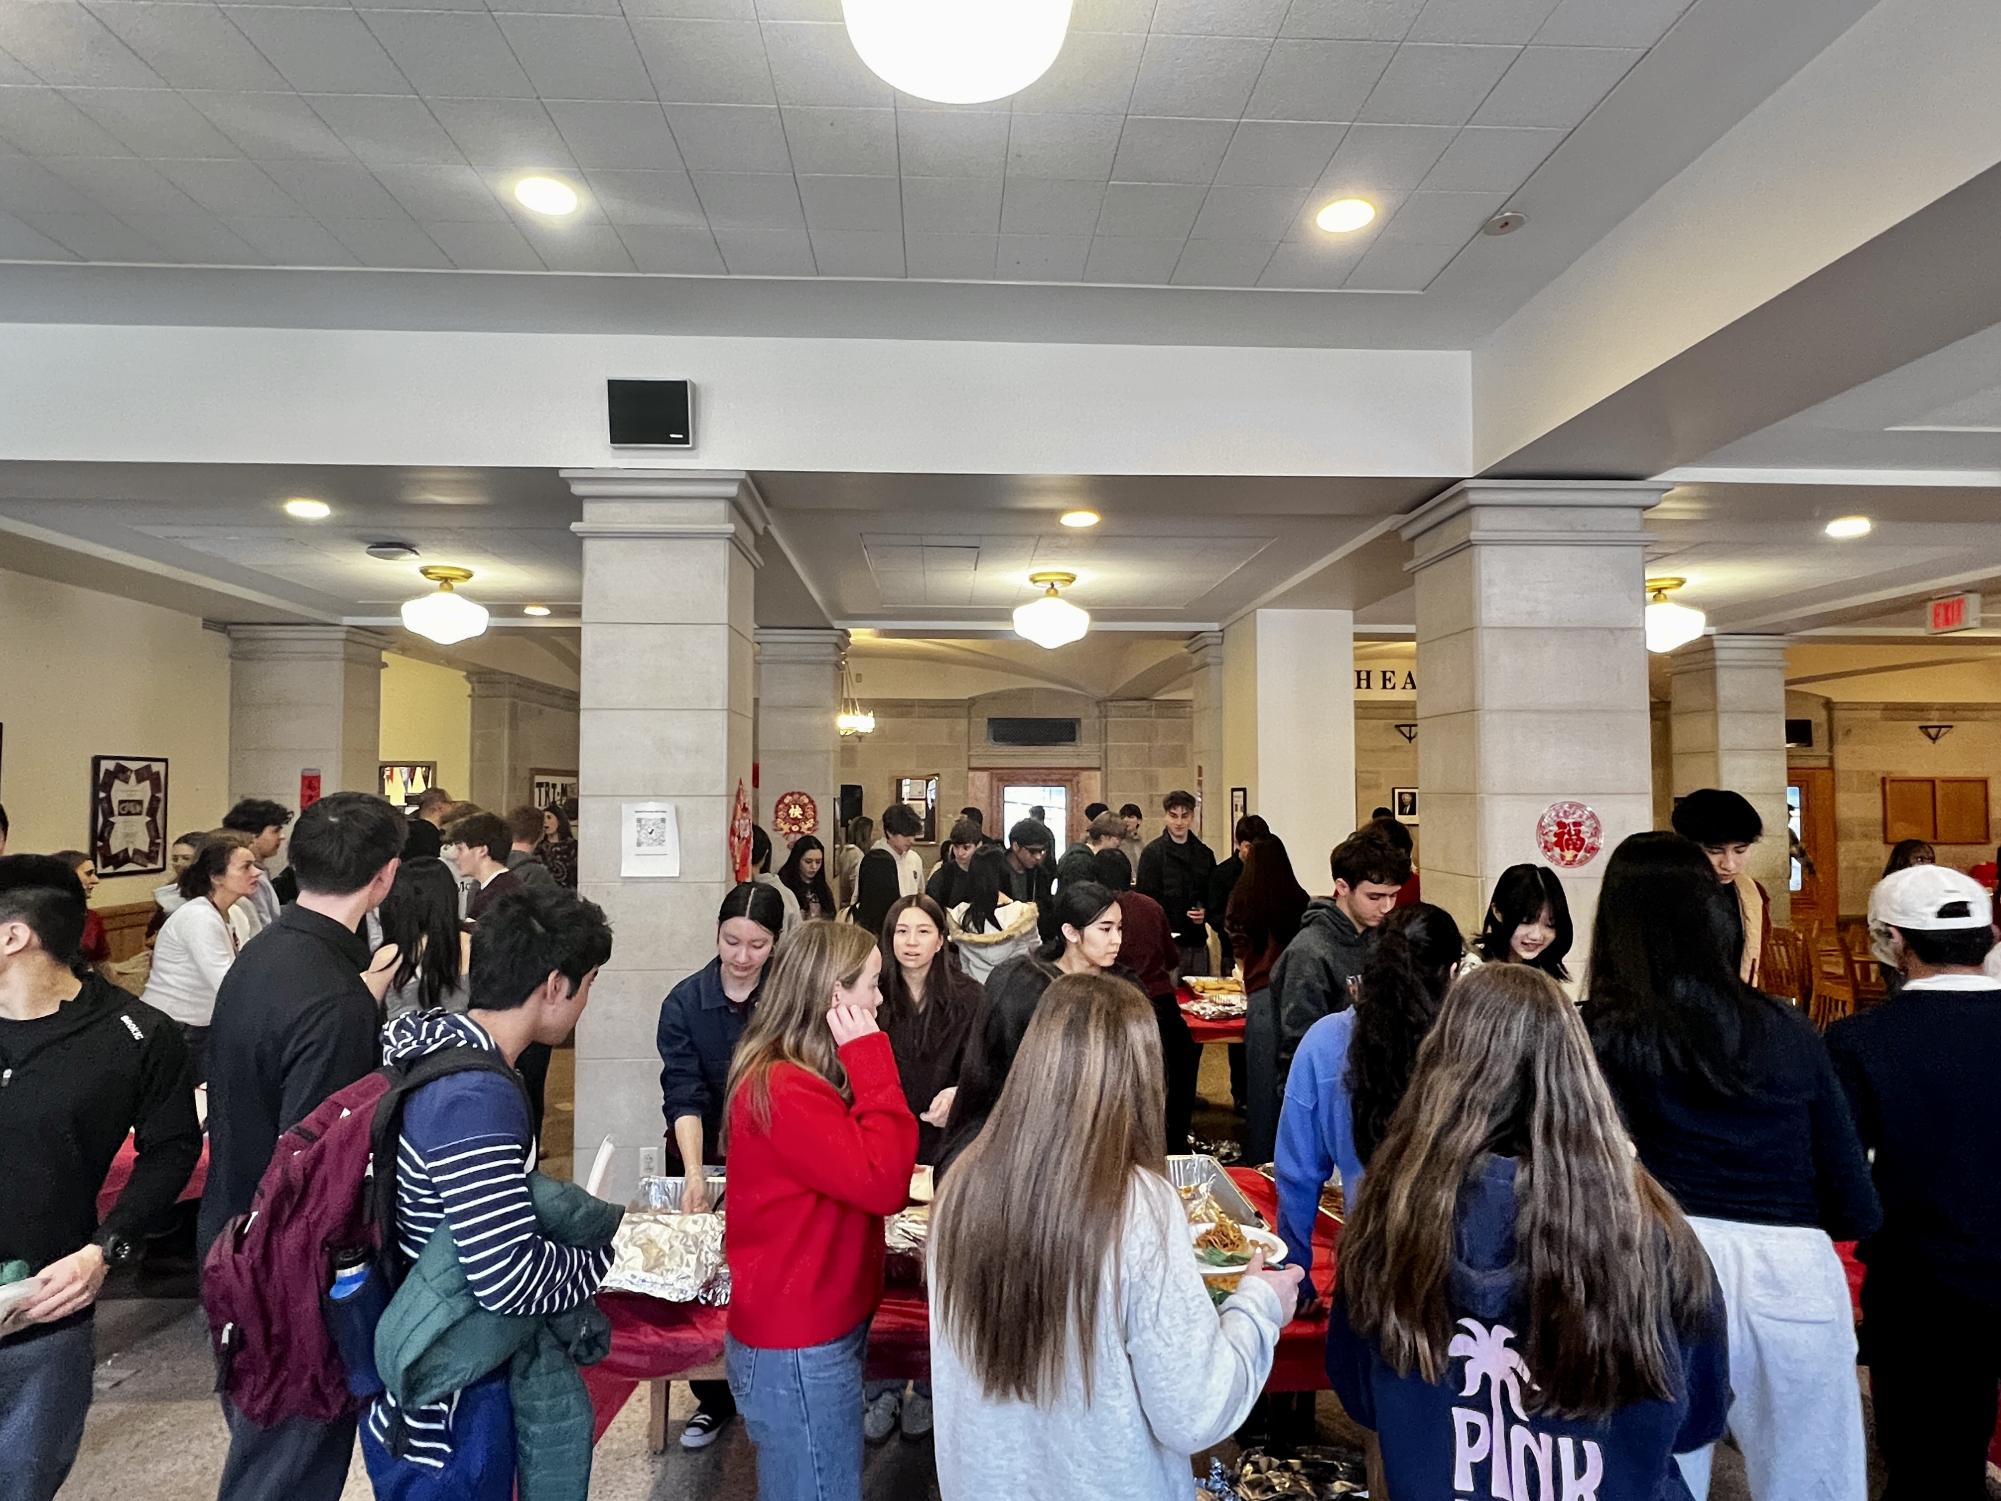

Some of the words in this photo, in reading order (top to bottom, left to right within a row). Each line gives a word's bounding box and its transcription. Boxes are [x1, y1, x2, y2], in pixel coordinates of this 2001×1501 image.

[1933, 597, 1965, 628] EXIT
[1354, 670, 1417, 690] HEA
[1553, 820, 1586, 853] 福
[1451, 1406, 1604, 1501] PINK
